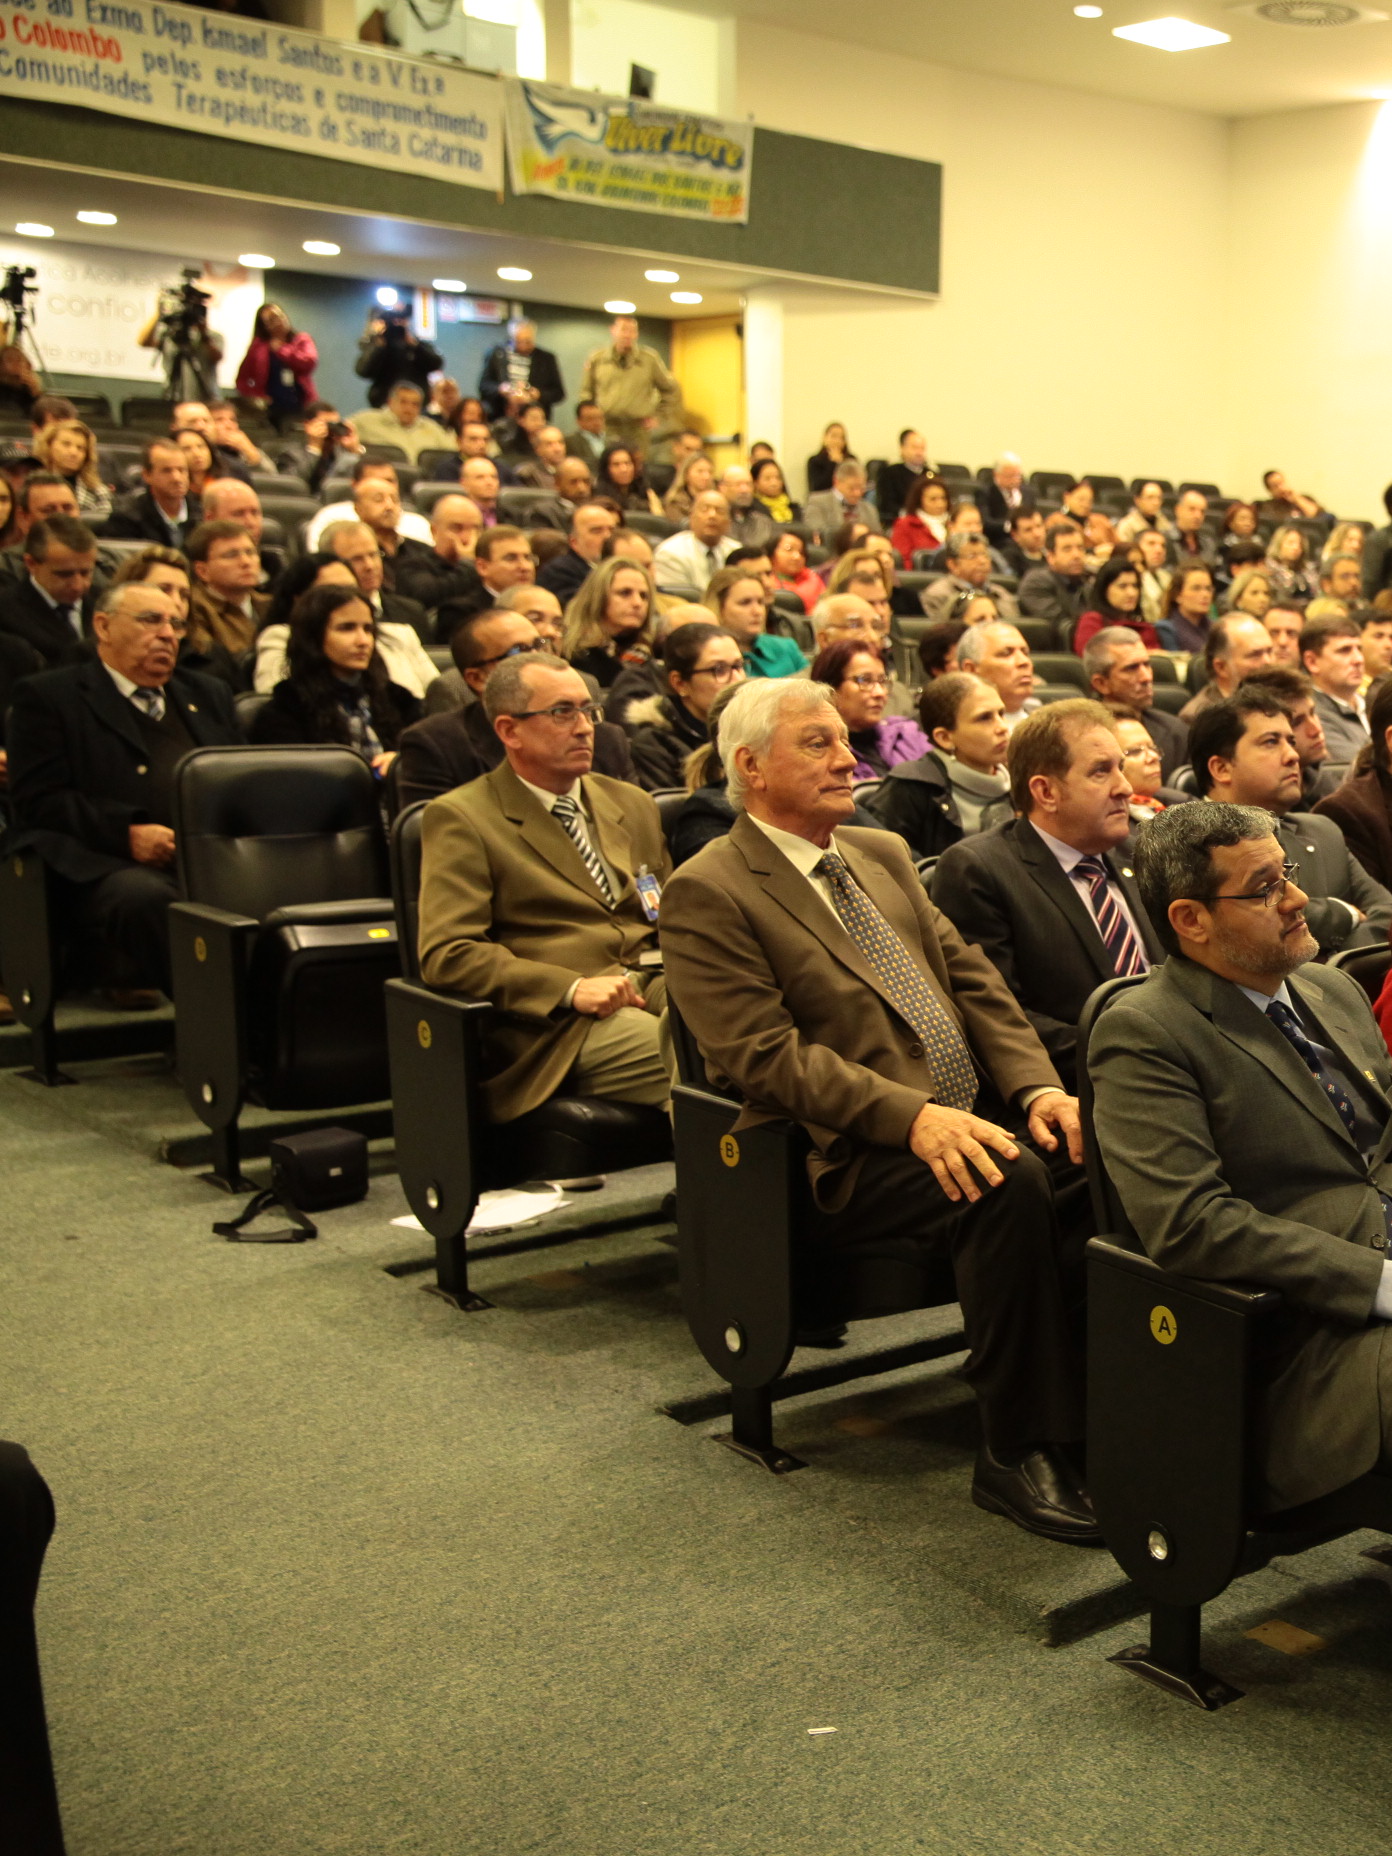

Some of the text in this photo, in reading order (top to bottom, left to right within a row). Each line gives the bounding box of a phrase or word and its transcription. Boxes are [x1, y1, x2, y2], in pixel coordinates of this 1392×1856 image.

[13, 14, 123, 64] Colombo
[142, 49, 202, 82] pelos
[214, 64, 305, 105] esforços
[314, 87, 326, 109] e
[335, 90, 488, 142] comprometimento
[202, 17, 268, 59] Ismael
[277, 35, 344, 77] Santos
[353, 57, 364, 82] e
[319, 114, 339, 143] de
[345, 118, 400, 155] Santa
[407, 132, 484, 173] Catarina
[725, 1141, 735, 1158] B
[1158, 1315, 1172, 1337] A
